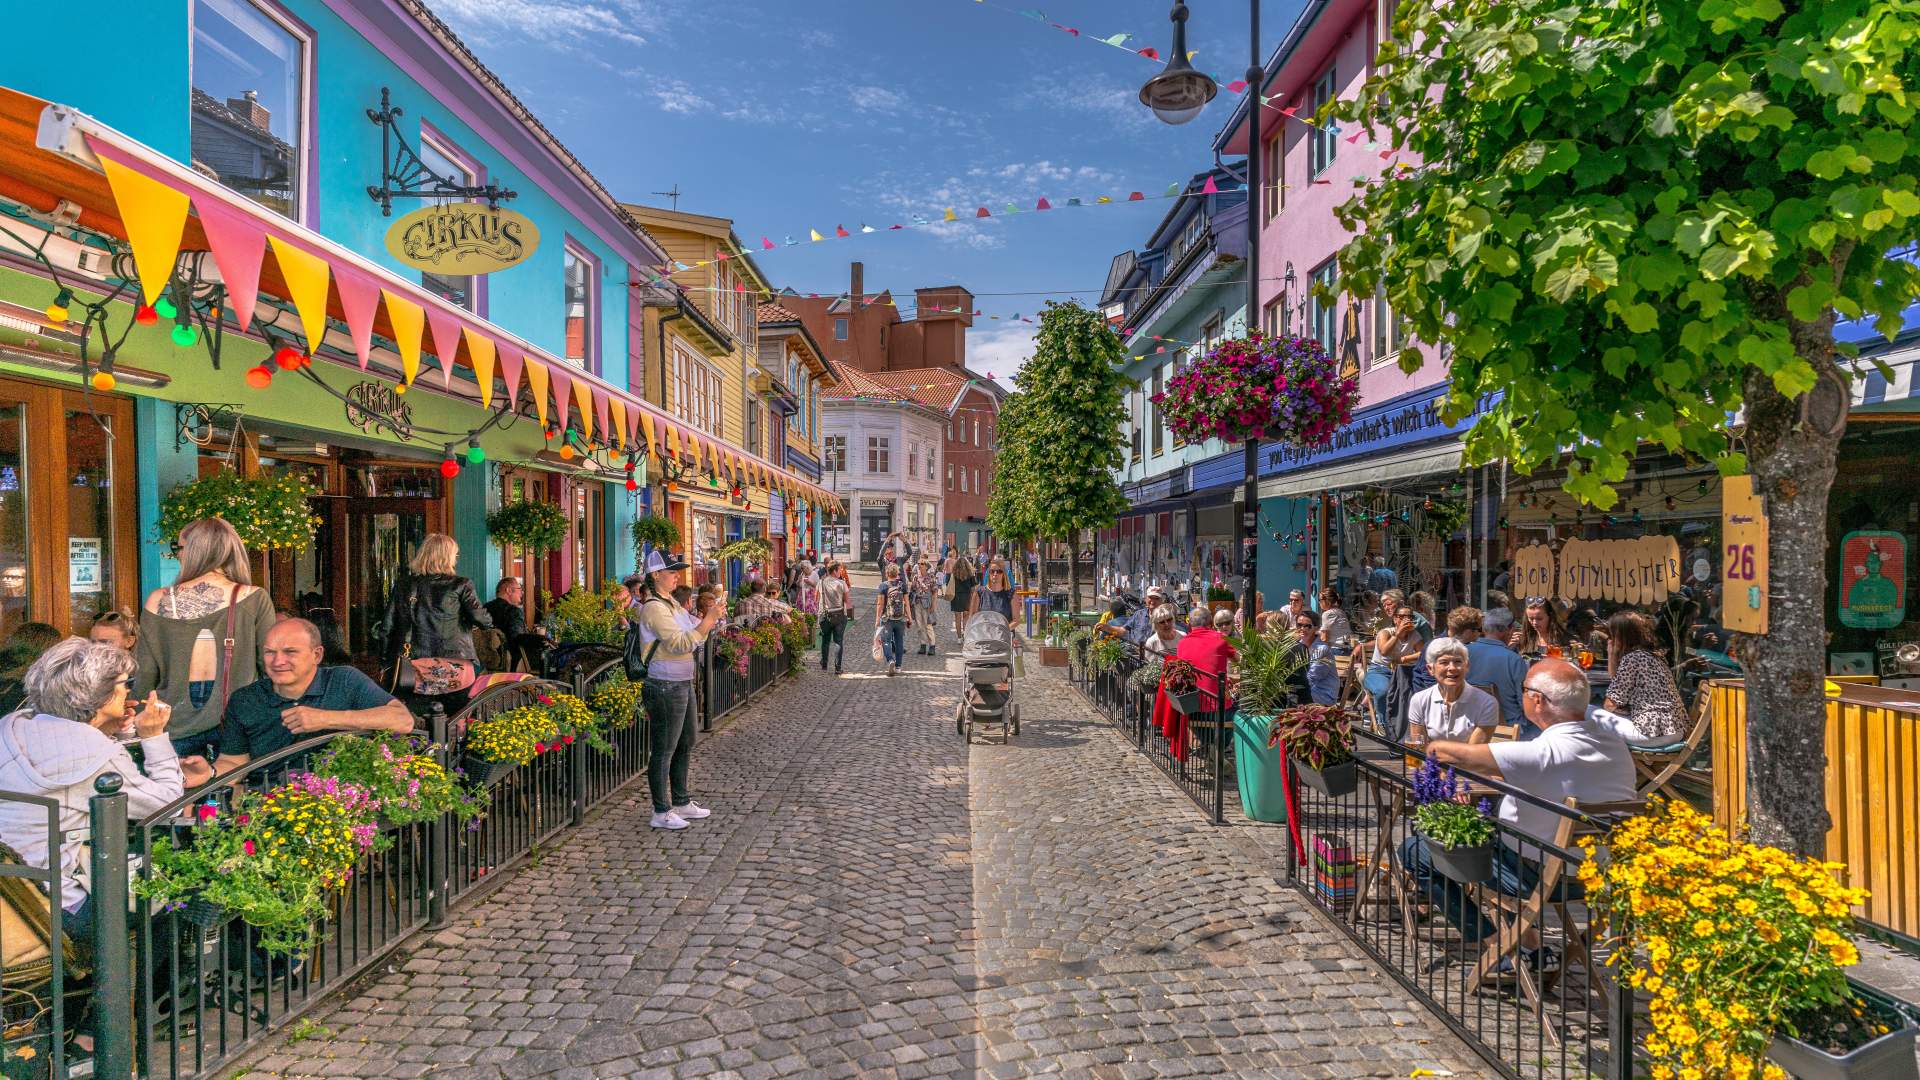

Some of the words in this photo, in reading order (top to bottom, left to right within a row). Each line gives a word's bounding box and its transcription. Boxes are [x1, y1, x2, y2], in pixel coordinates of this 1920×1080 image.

[402, 209, 524, 265] CIRKUS
[346, 381, 413, 441] CIRKUS
[1353, 414, 1390, 445] what's
[1391, 404, 1421, 435] with
[1516, 566, 1548, 585] BOB
[1569, 558, 1680, 588] STYLISTER
[1727, 544, 1755, 580] 26
